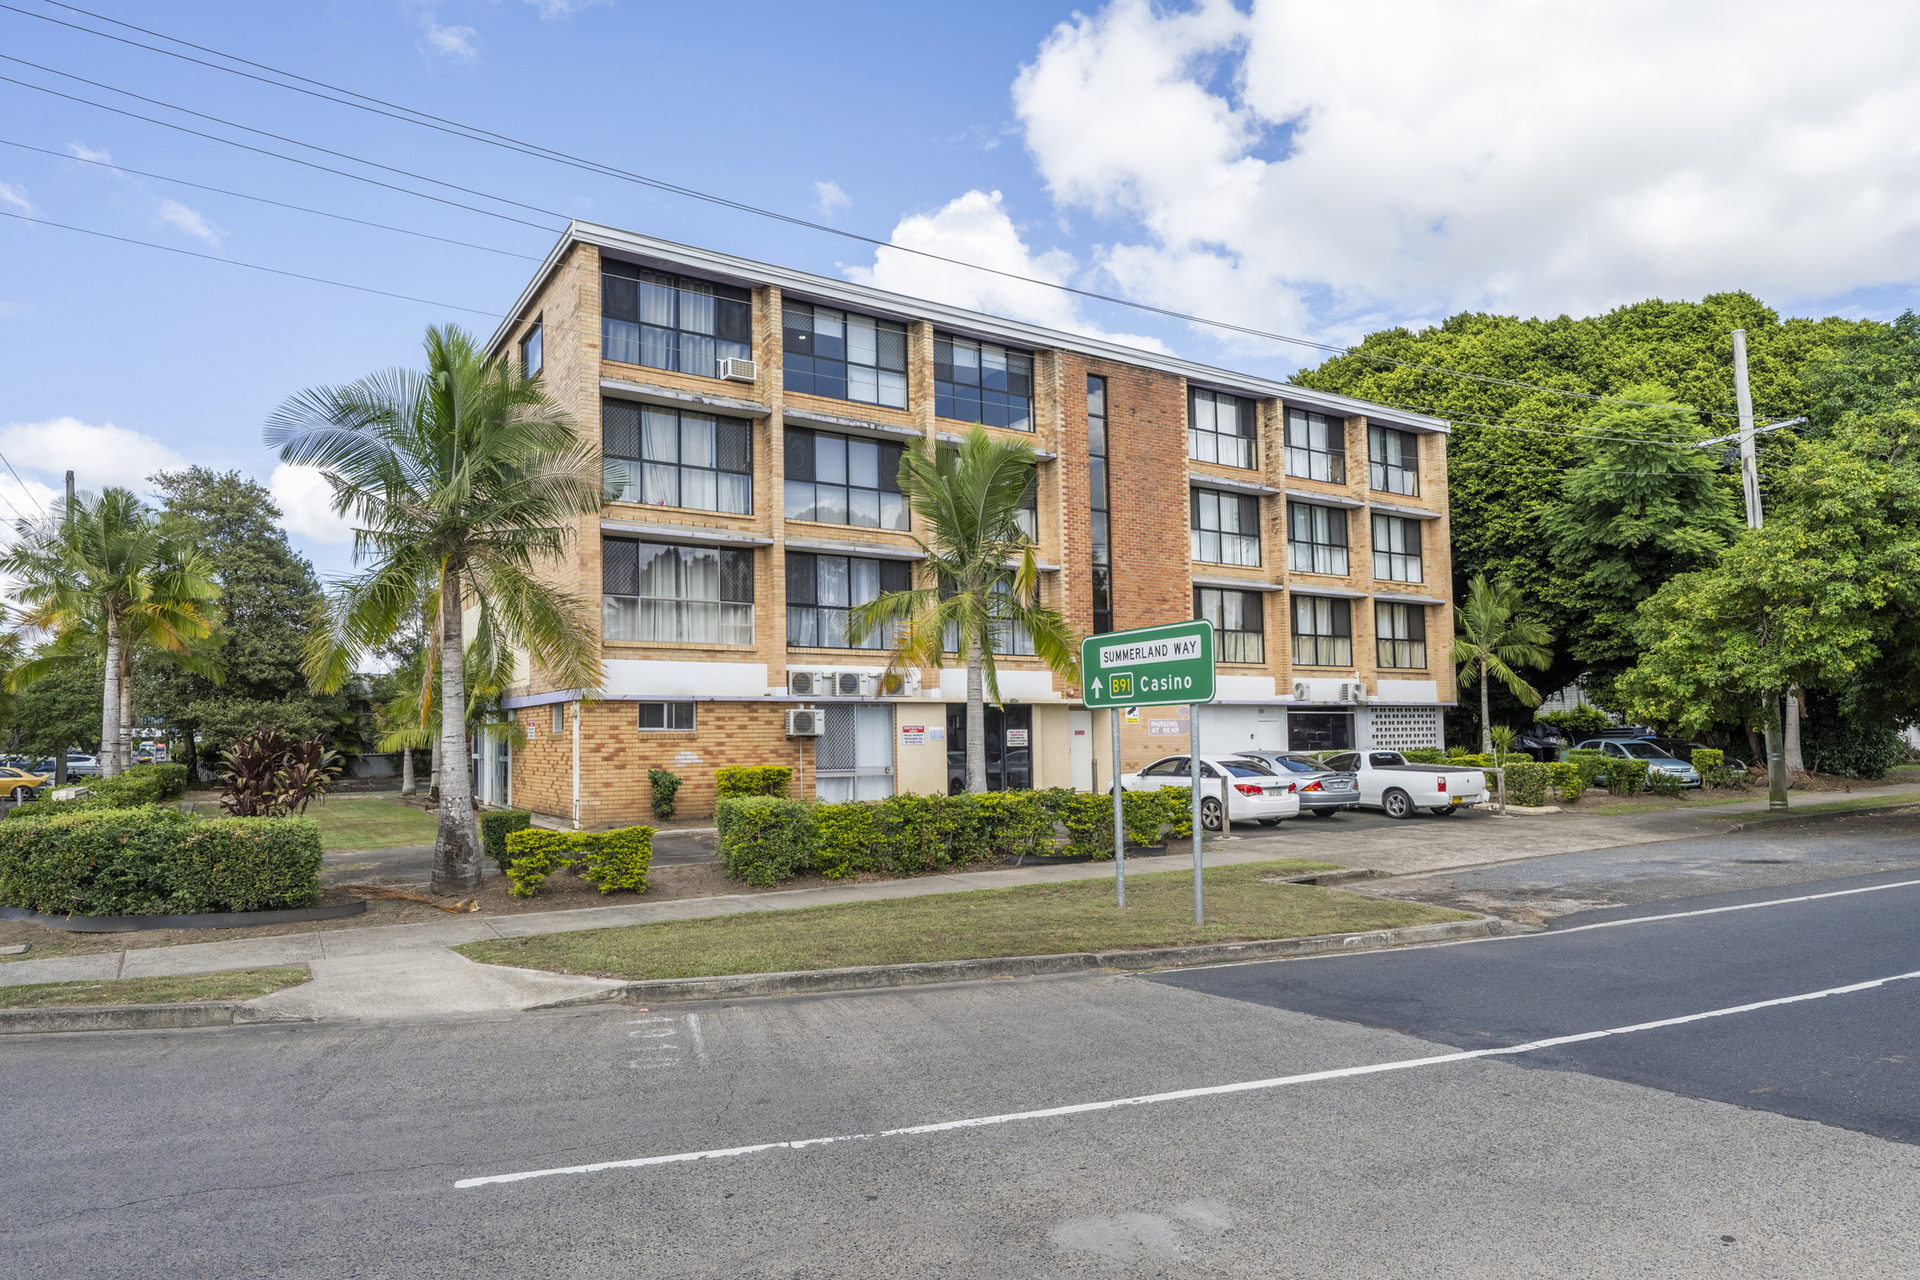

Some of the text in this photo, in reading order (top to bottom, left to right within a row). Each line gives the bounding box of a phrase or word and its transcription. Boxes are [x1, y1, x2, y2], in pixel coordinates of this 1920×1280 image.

[1103, 640, 1197, 663] SUMMERLAND WAY
[1112, 674, 1192, 693] B91 Casino
